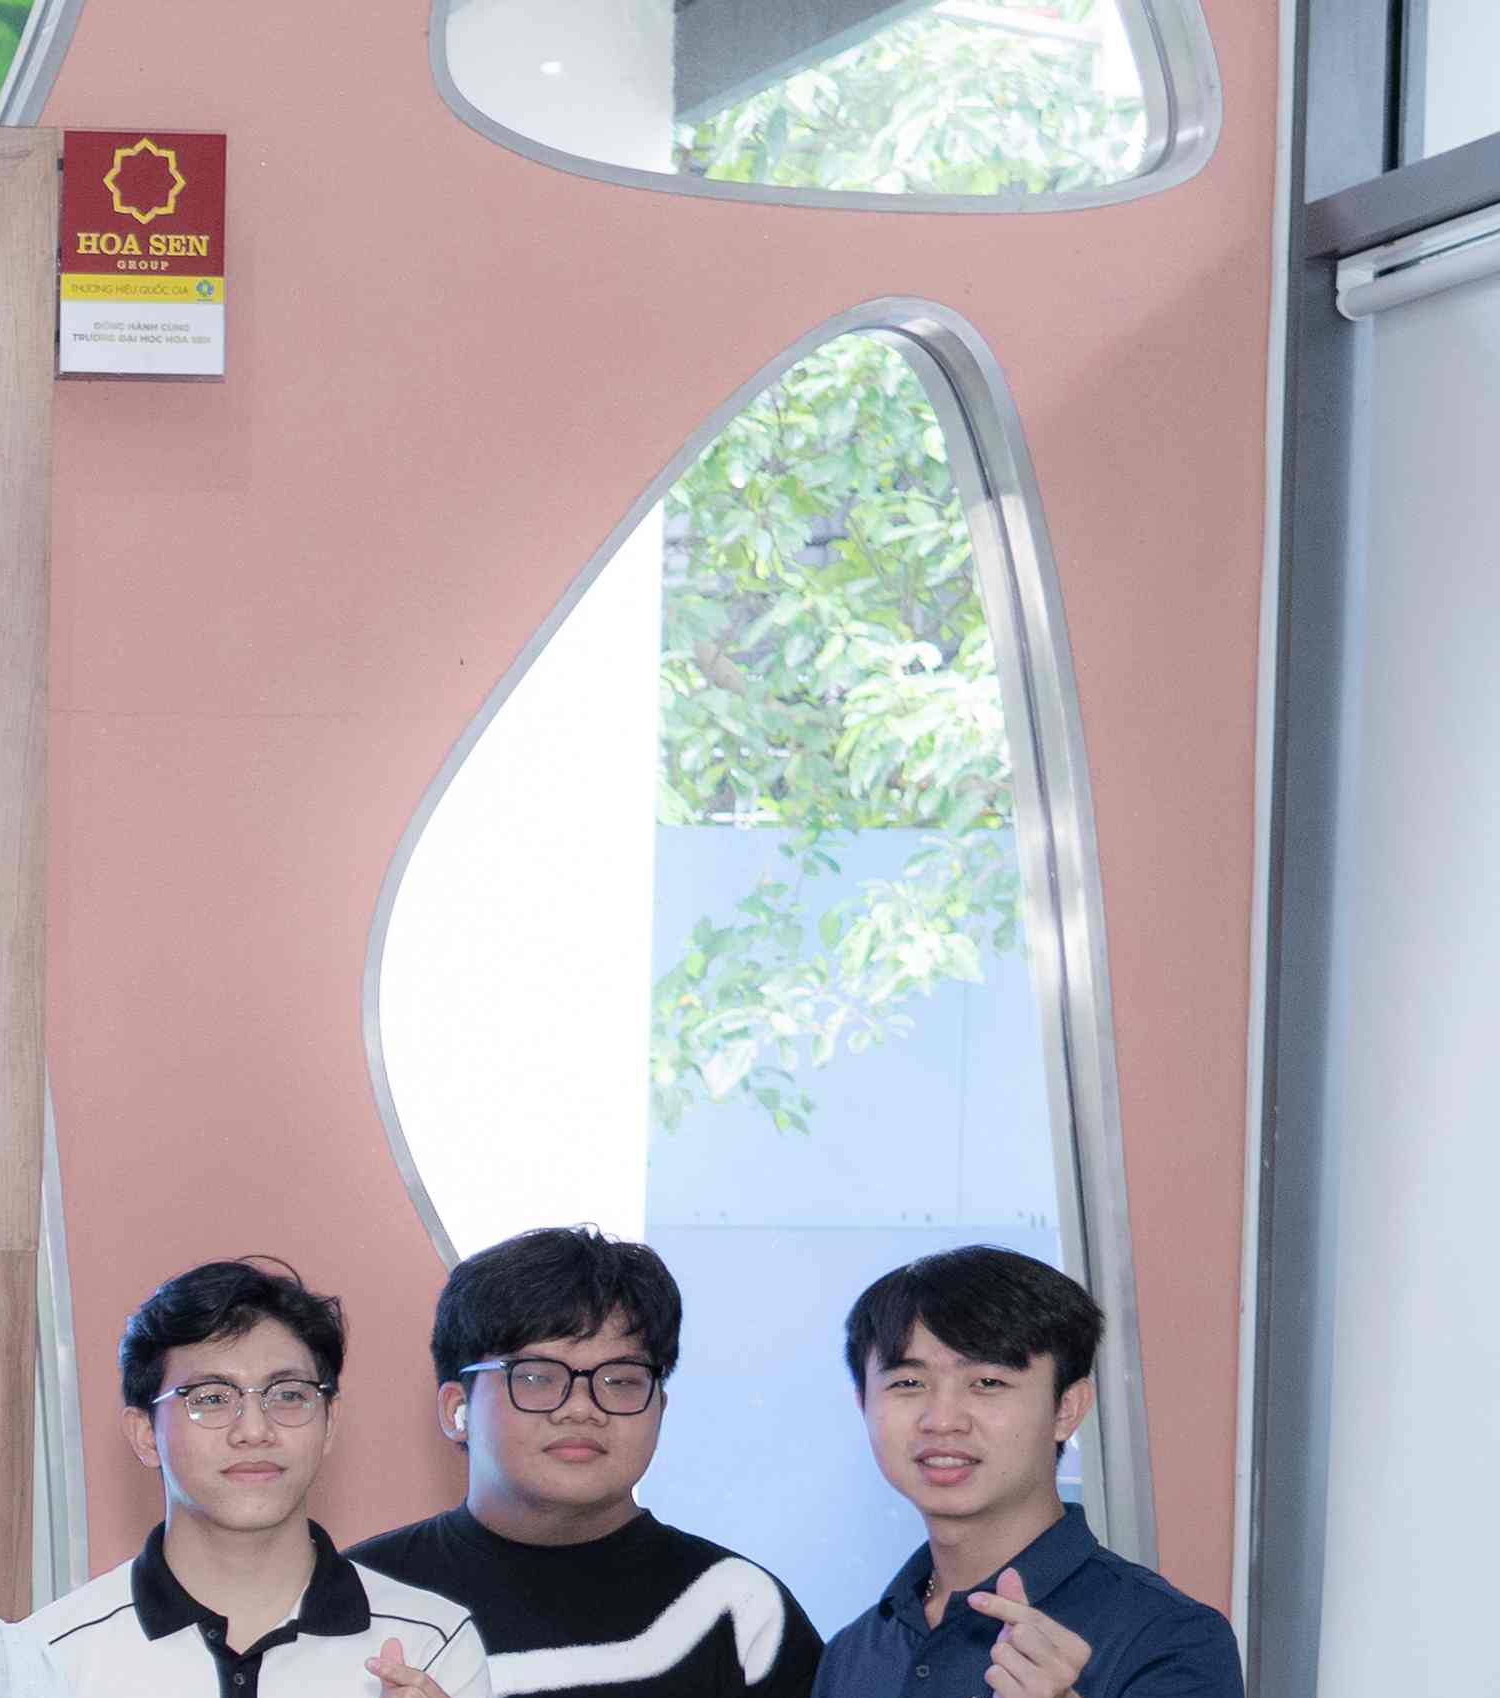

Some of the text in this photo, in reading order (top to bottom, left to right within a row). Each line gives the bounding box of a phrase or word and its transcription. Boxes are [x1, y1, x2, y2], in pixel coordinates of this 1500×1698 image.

[76, 232, 210, 257] HOA SEN
[116, 260, 170, 271] GROUP
[165, 335, 189, 344] HOA
